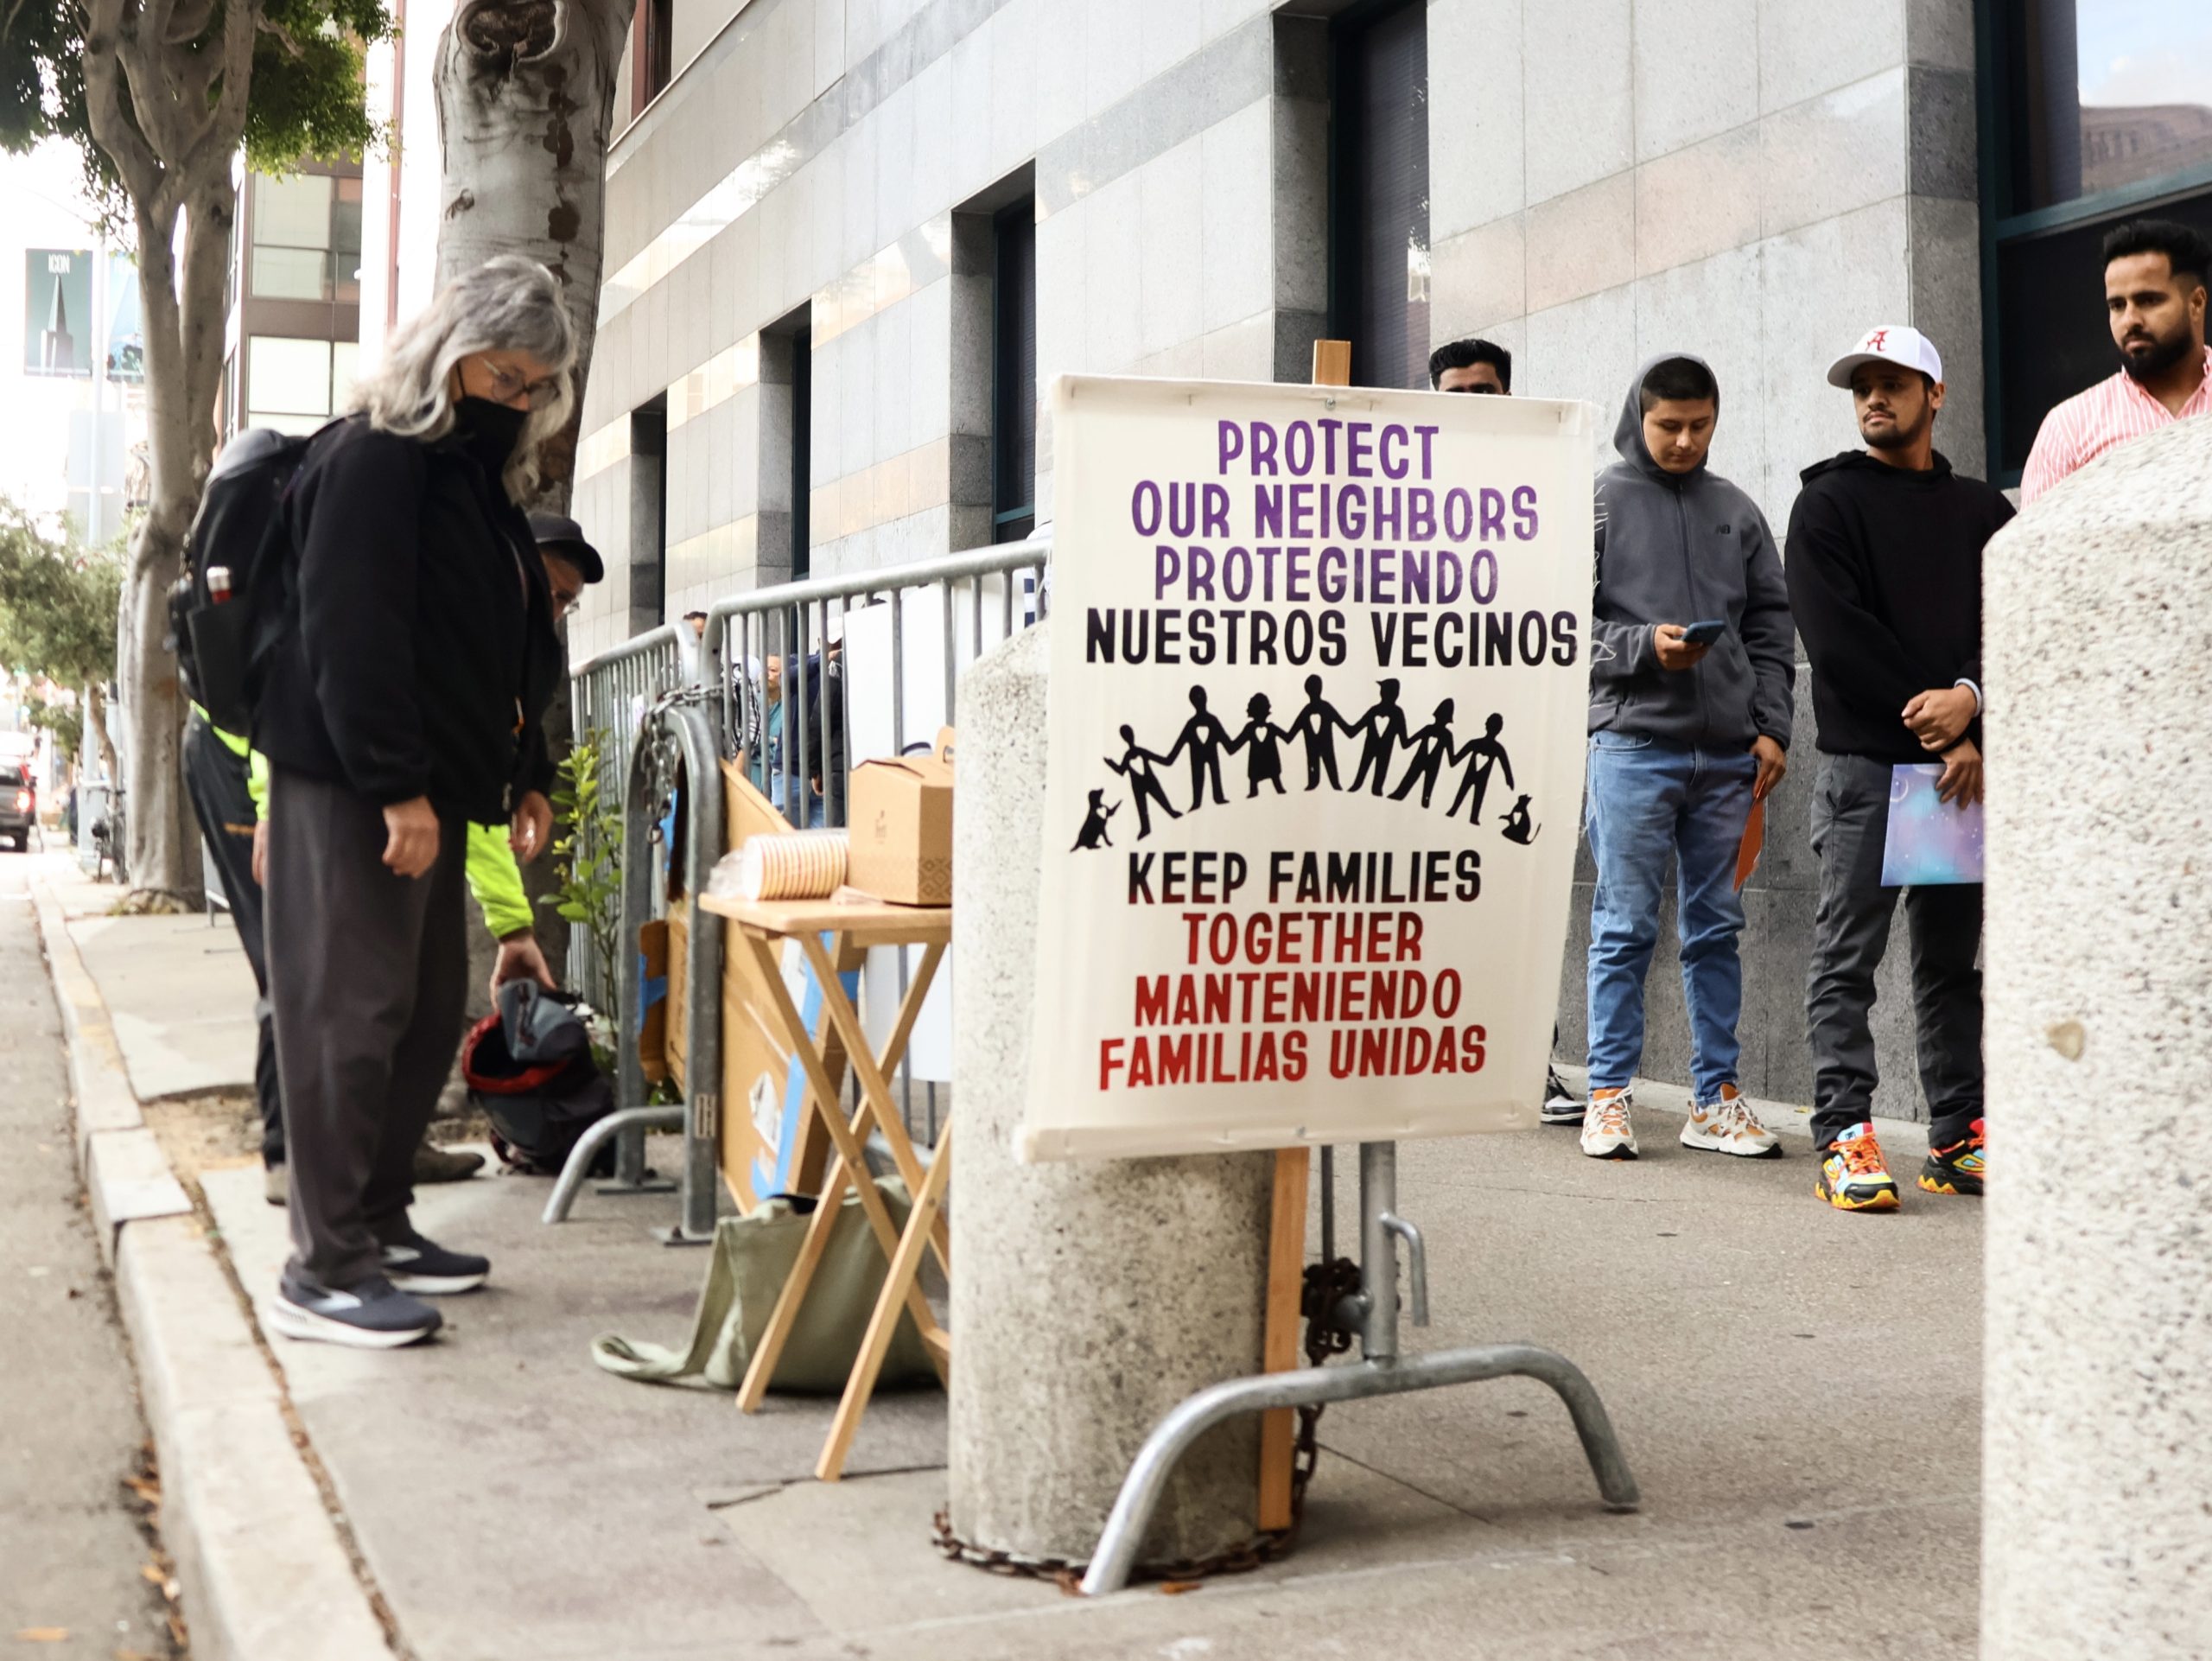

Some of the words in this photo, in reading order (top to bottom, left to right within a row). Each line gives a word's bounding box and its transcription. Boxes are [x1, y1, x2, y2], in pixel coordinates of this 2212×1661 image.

[48, 253, 71, 274] ICON
[1218, 419, 1439, 480] PROTECT
[1132, 480, 1230, 538] OUR
[1255, 484, 1538, 542] NEIGHBORS
[1155, 546, 1498, 605] PROTEGIENDO
[1086, 608, 1347, 666] NUESTROS
[1370, 609, 1578, 668] VECINOS
[1128, 851, 1248, 905] KEEP
[1268, 850, 1482, 905] FAMILIES
[1182, 911, 1423, 965] TOGETHER
[1135, 968, 1462, 1028] MANTENIENDO
[1099, 1028, 1308, 1091] FAMILIAS
[1328, 1023, 1487, 1080] UNIDAS
